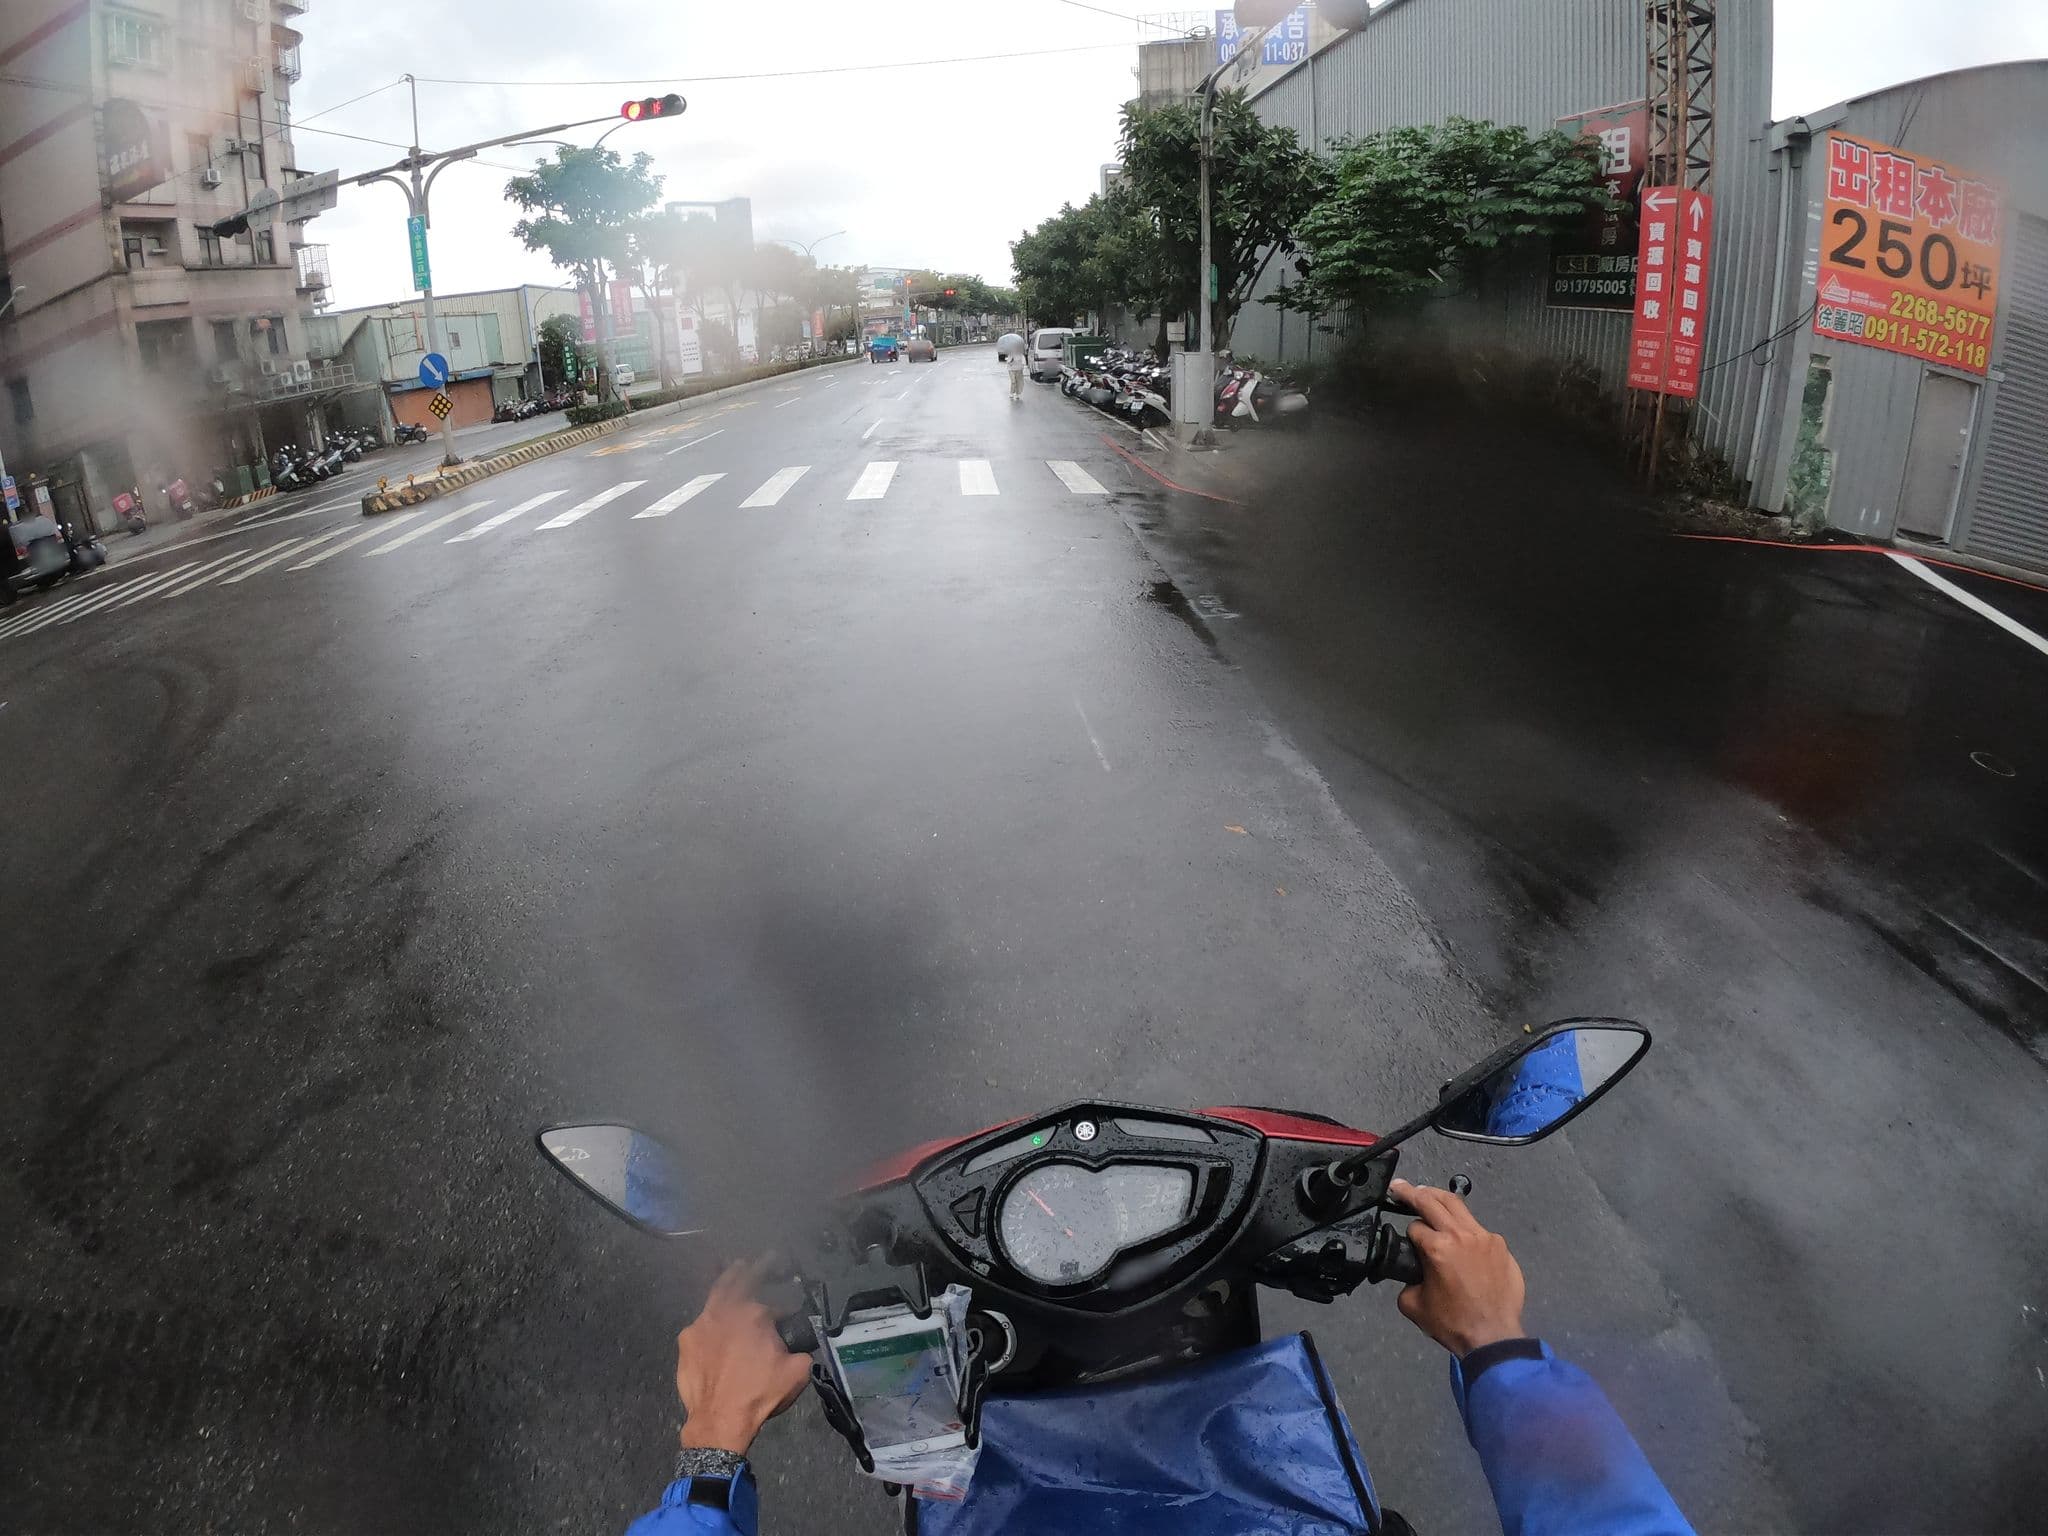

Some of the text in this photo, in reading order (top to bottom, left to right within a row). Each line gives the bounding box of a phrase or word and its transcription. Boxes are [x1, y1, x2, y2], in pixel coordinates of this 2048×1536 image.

[1828, 136, 1999, 245] 出租本廠
[1555, 278, 1627, 296] 0913795005
[1643, 222, 1666, 320] 資源回收
[1680, 238, 1702, 338] 資源回收
[1864, 315, 1986, 369] 0911-572-118
[1889, 290, 1991, 340] 2268-5677
